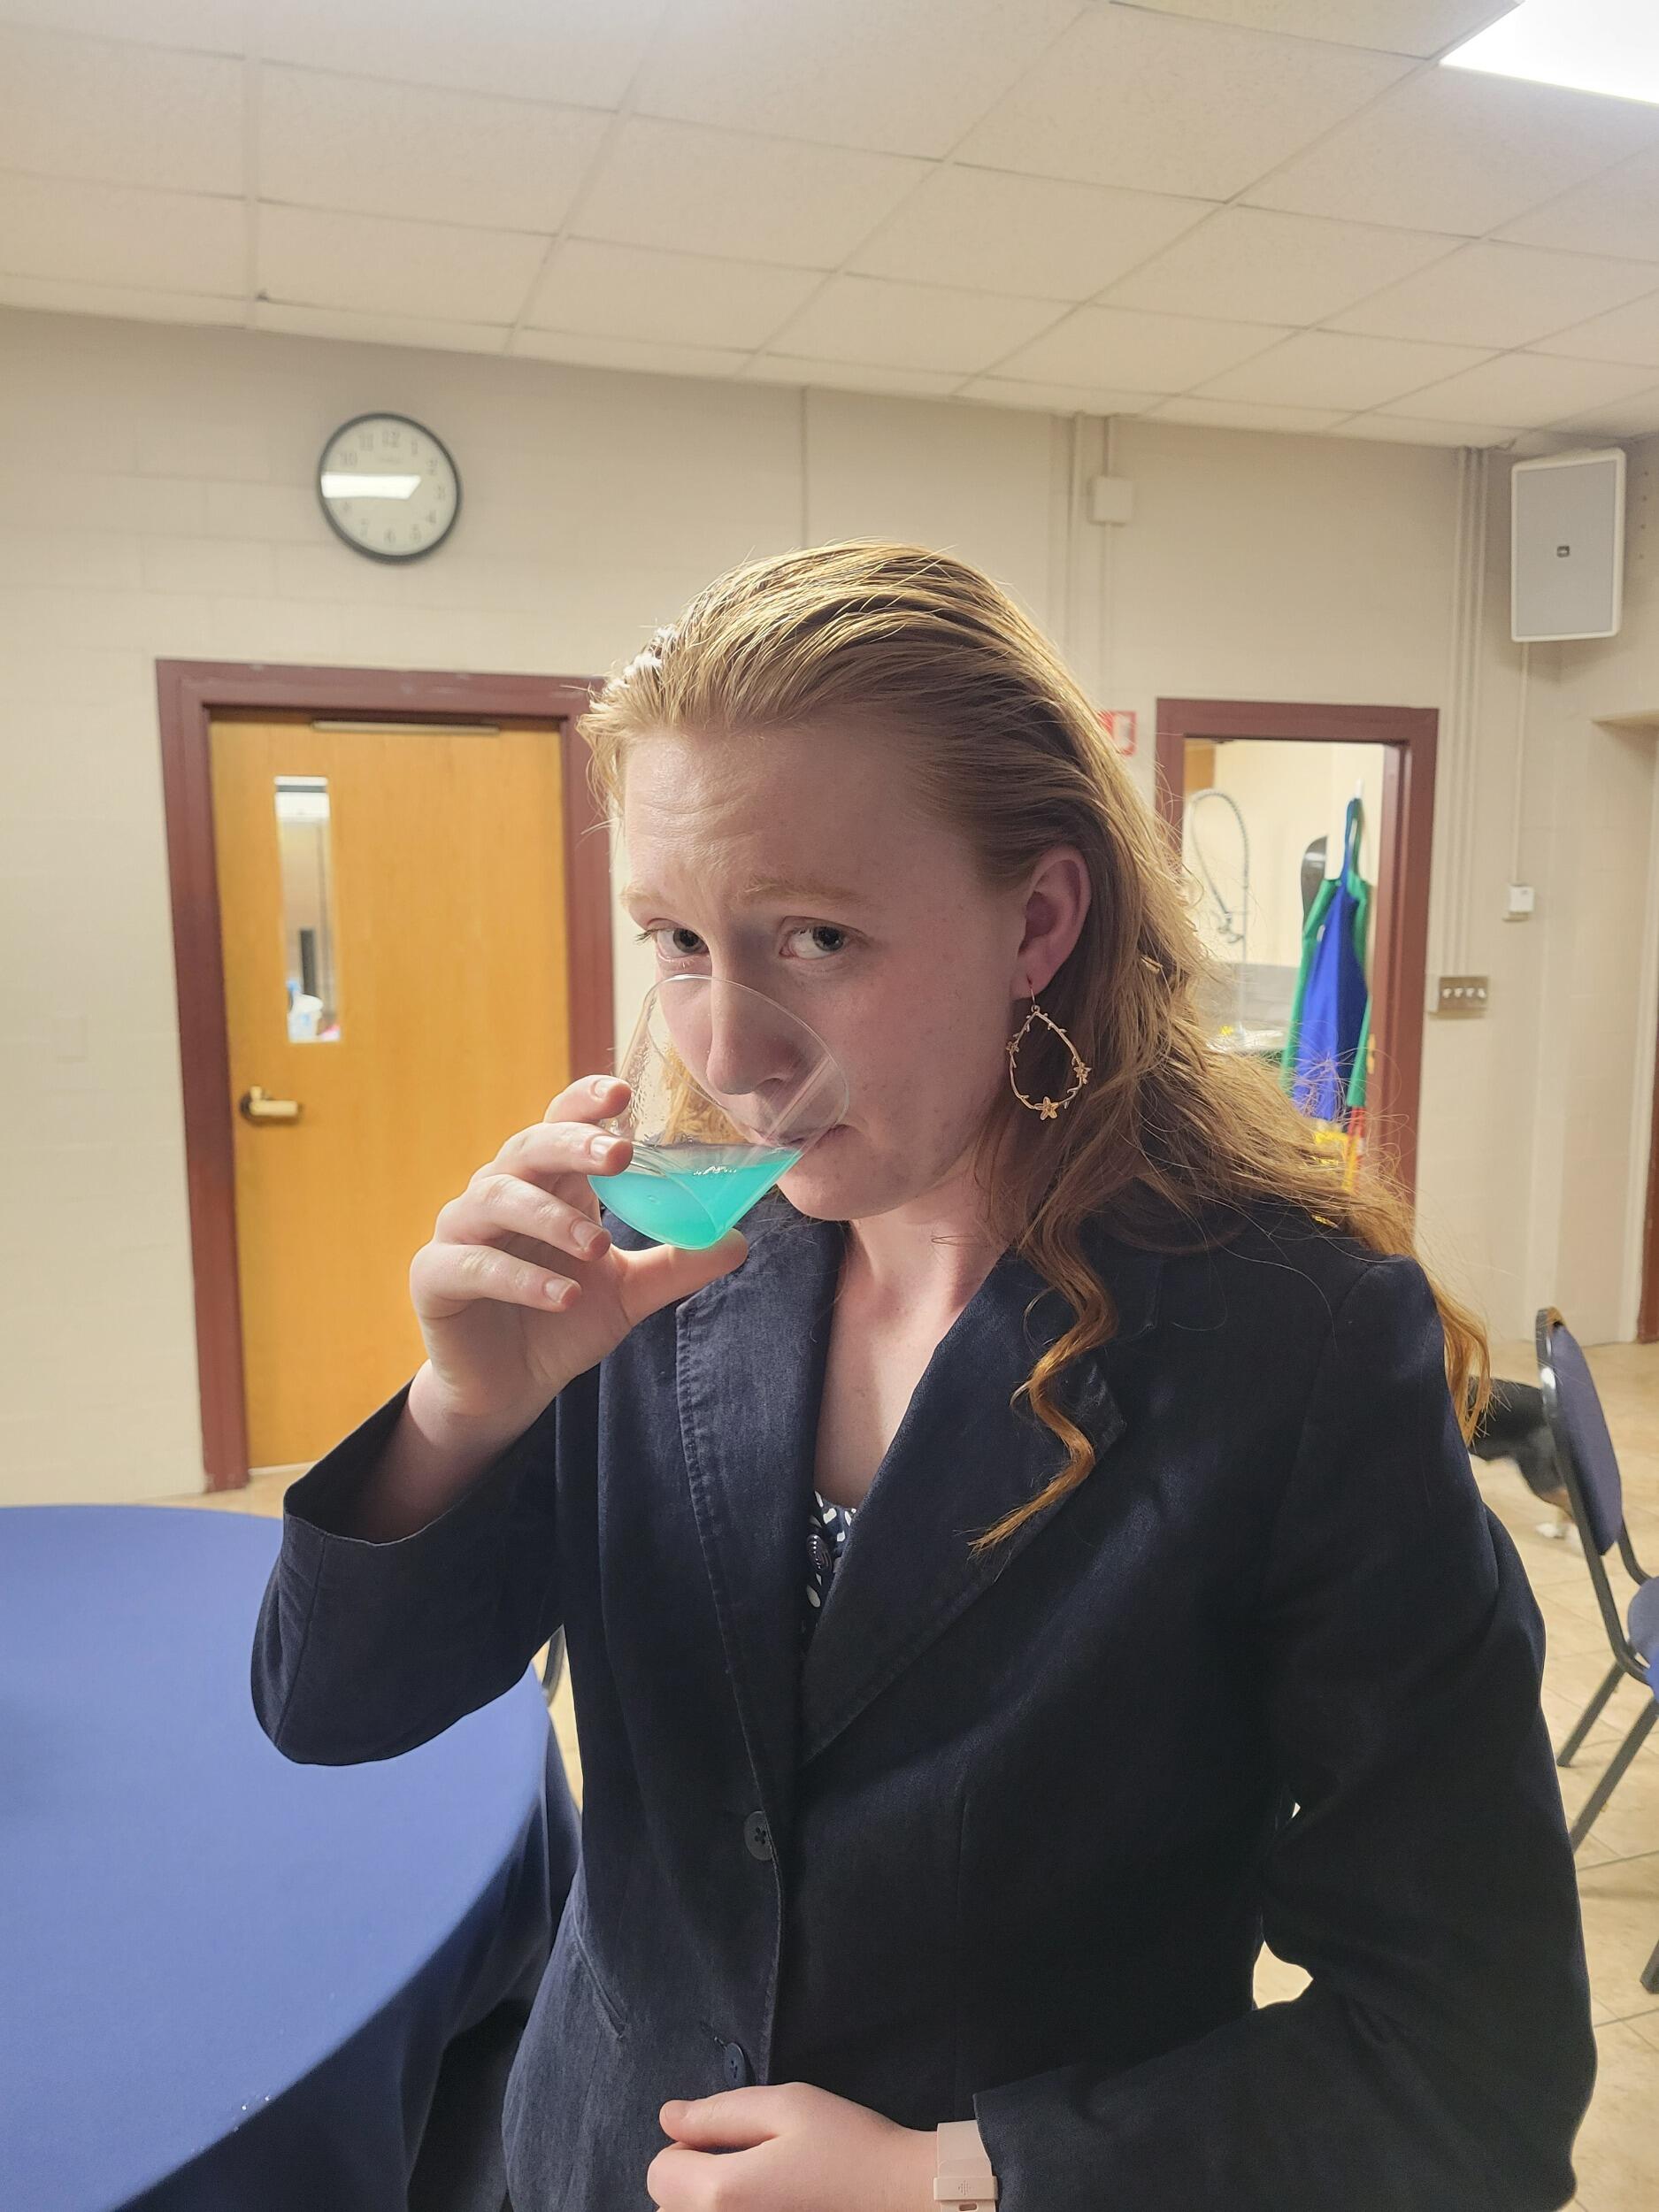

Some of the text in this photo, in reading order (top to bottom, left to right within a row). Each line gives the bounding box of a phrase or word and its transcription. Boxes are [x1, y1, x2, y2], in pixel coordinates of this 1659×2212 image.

[359, 434, 373, 451] 11
[381, 430, 400, 448] 12
[340, 452, 357, 467] 10
